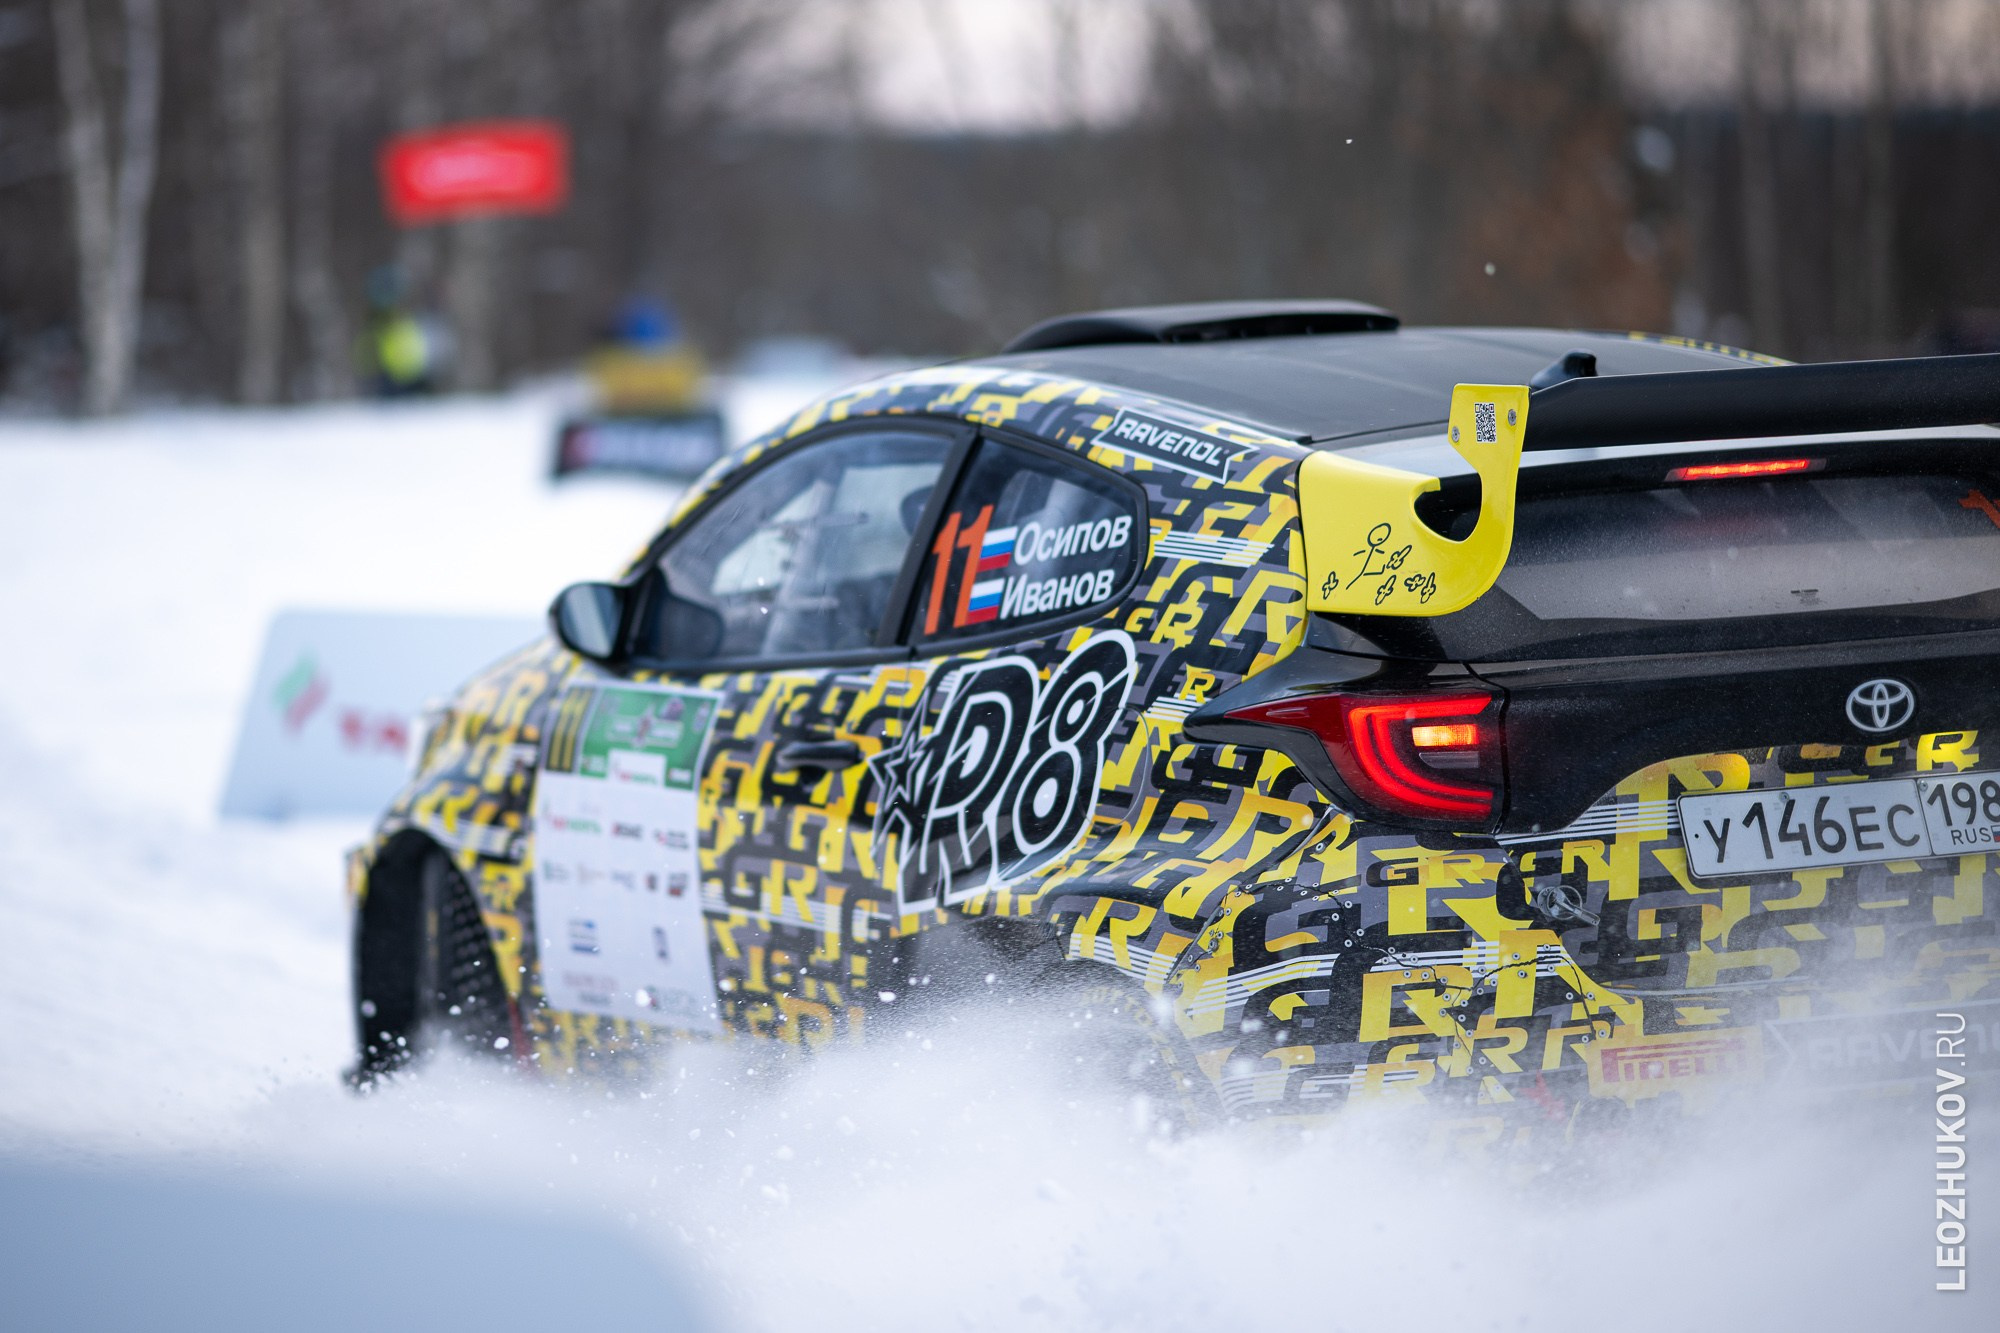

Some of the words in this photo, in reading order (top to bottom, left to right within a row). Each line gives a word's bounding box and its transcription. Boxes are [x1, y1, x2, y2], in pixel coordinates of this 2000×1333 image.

[1114, 418, 1223, 467] RAVENOL
[1013, 515, 1132, 565] Осипов
[924, 505, 994, 635] 11
[1000, 569, 1115, 620] Иванов
[1927, 779, 2000, 827] 198
[1951, 827, 1992, 845] RUS
